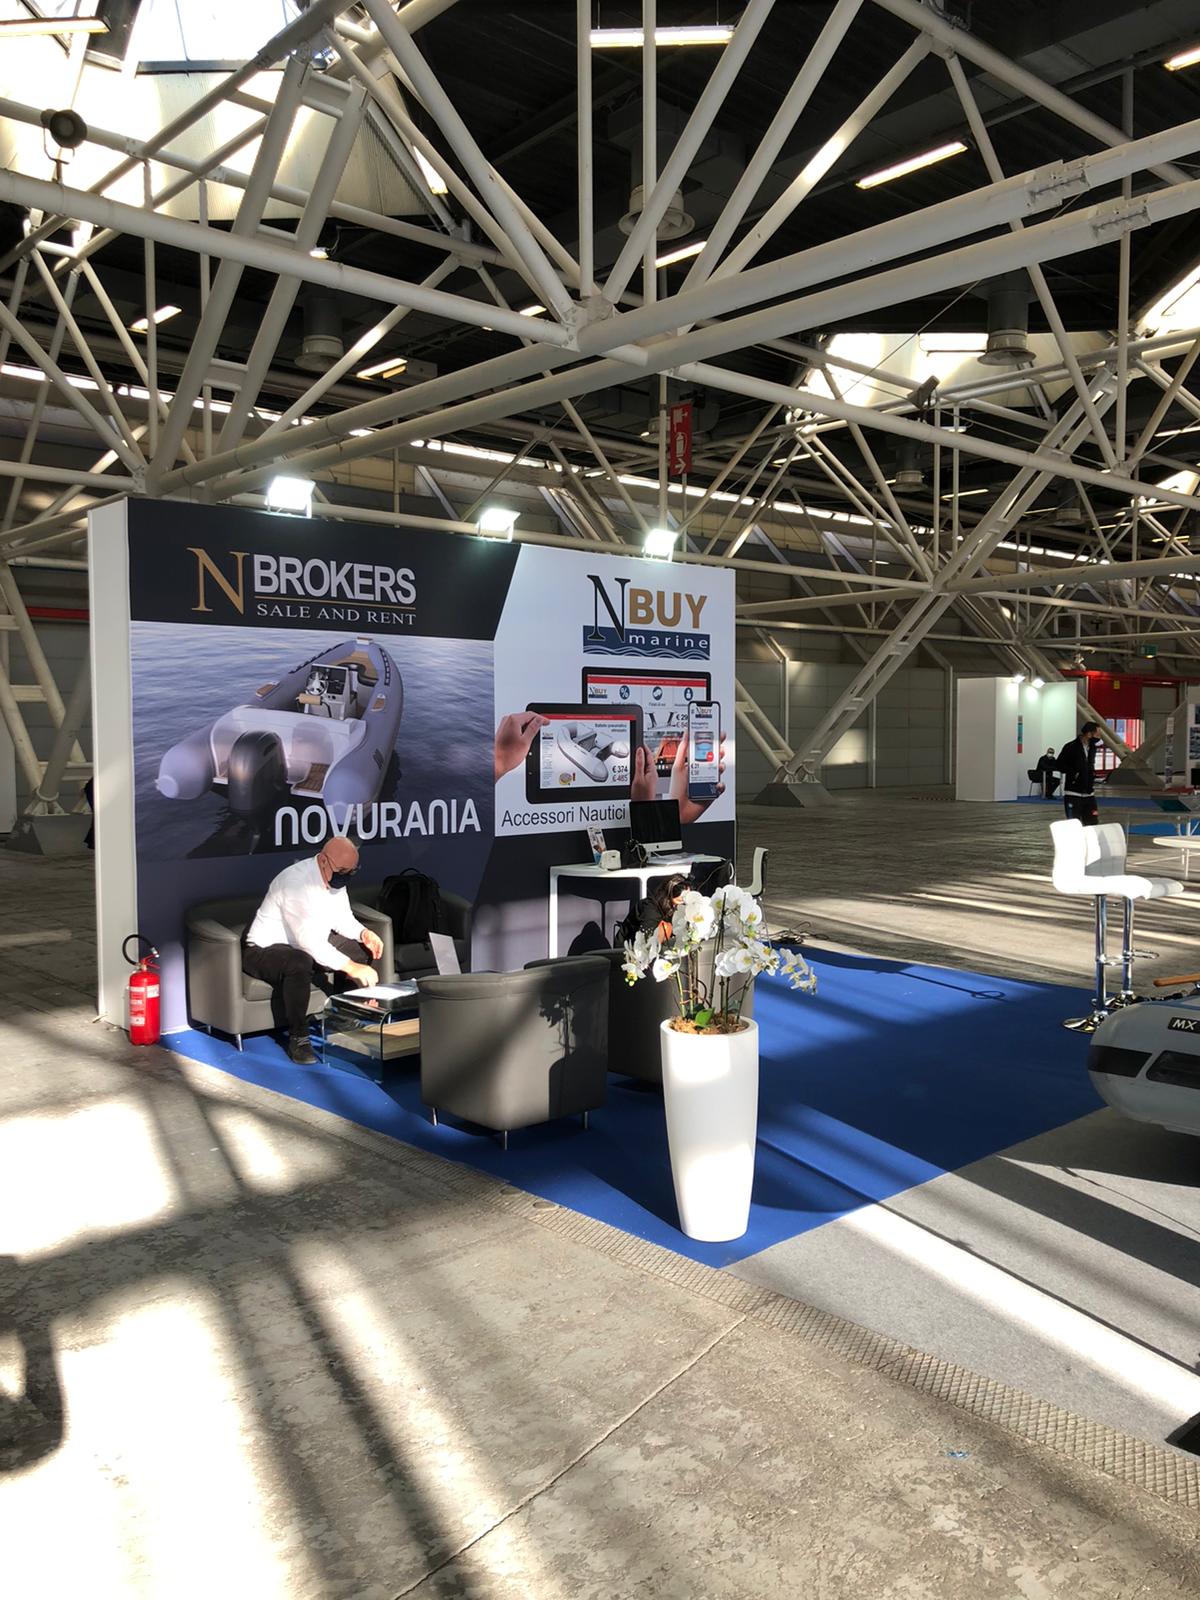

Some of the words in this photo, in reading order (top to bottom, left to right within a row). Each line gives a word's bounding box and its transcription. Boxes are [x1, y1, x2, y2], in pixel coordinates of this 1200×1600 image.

[257, 604, 311, 618] SALE
[317, 608, 360, 622] AND
[367, 612, 417, 625] RENT
[629, 634, 709, 649] marine
[501, 807, 575, 827] Accessori
[579, 804, 626, 822] Nautici
[1172, 1018, 1198, 1031] MX
